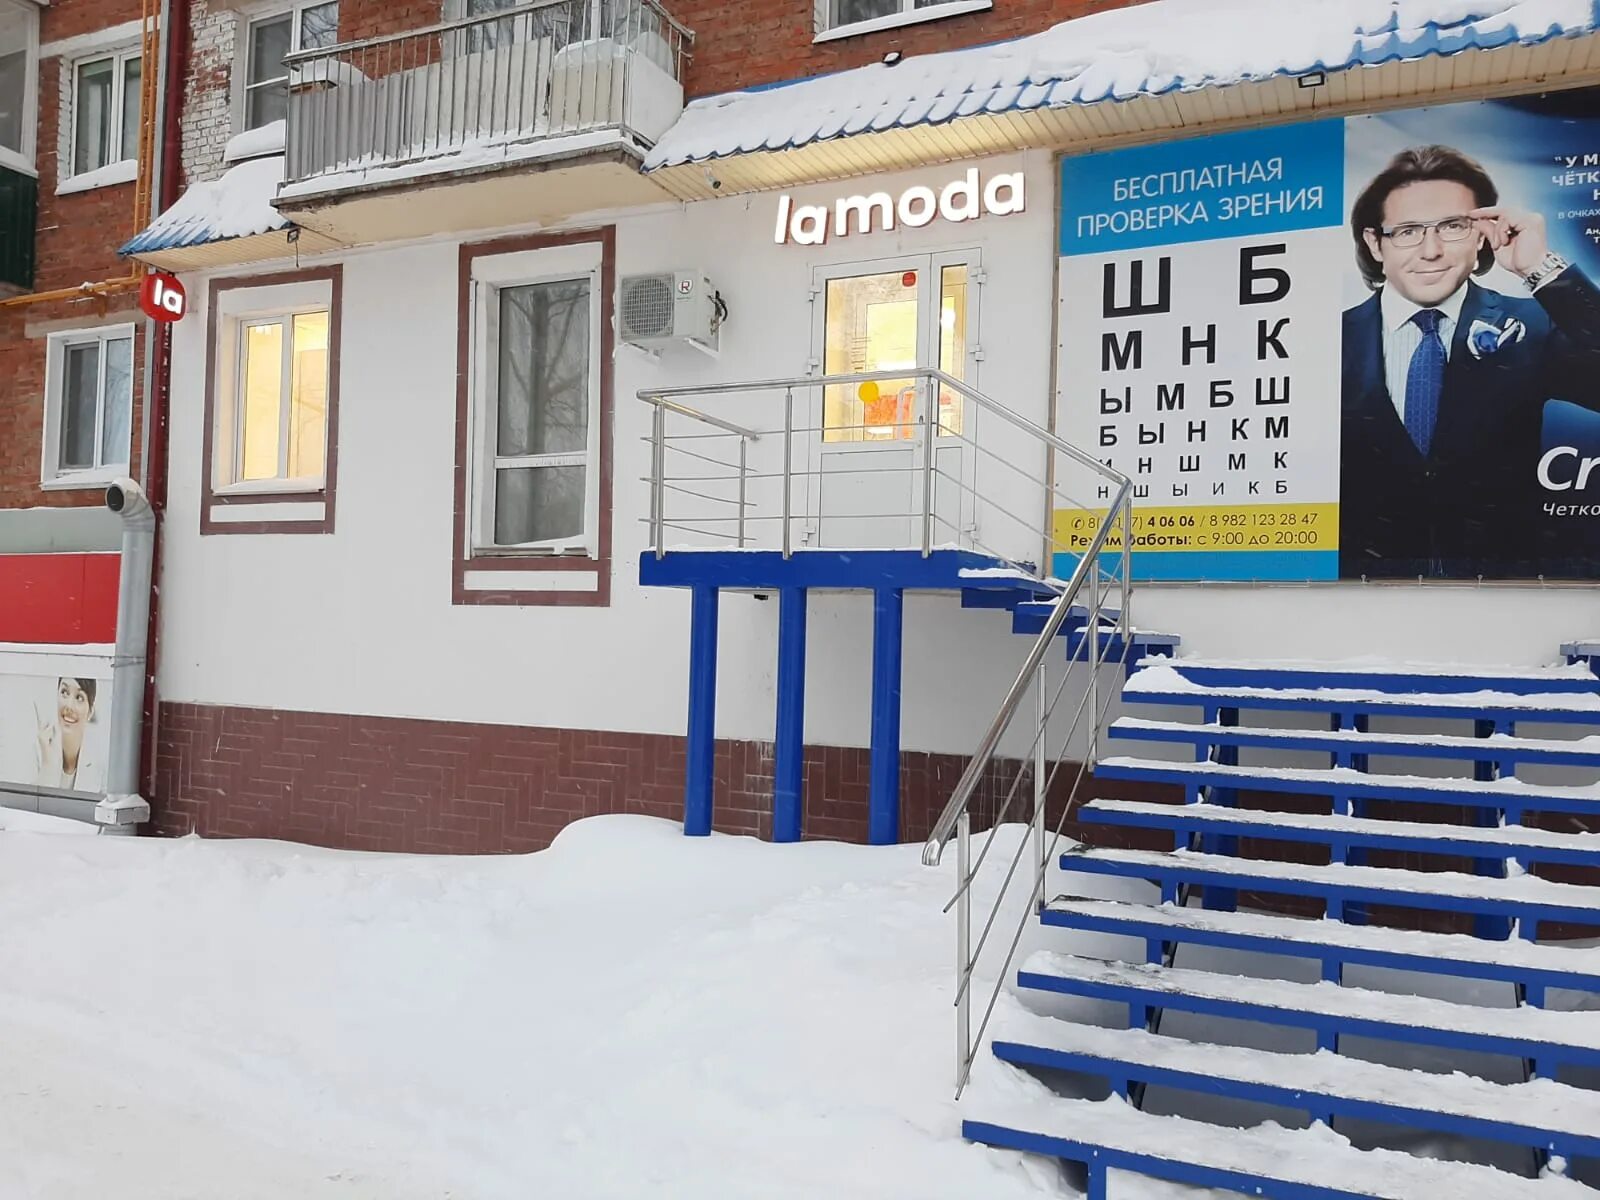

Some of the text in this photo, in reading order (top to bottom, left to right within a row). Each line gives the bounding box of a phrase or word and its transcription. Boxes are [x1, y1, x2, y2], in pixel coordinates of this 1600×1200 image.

[1113, 157, 1283, 202] БЕСПЛАТНАЯ
[774, 167, 1026, 245] lamoda
[1077, 186, 1324, 238] ПРОВЕРКА ЗРЕНИЯ
[153, 278, 183, 315] la
[1102, 243, 1291, 319] Ш Б
[1101, 317, 1290, 372] М Н К
[1100, 376, 1290, 415] Ы М Б Ш
[1099, 416, 1289, 447] Б Ы Н К М
[1138, 451, 1288, 474] Н Ш М К
[1097, 480, 1288, 499] Н Ш Ы И К Б
[1147, 516, 1155, 527] 4
[1159, 516, 1175, 527] 06
[1179, 515, 1195, 526] 06
[1209, 514, 1218, 527] 8
[1221, 514, 1246, 526] 982
[1252, 513, 1276, 526] 123
[1280, 513, 1297, 526] 28
[1301, 513, 1318, 525] 47
[1543, 502, 1600, 516] Четко
[1071, 534, 1122, 546] Реим
[1212, 532, 1244, 545] 9:00
[1248, 534, 1270, 546] до
[1275, 531, 1318, 544] 20:00
